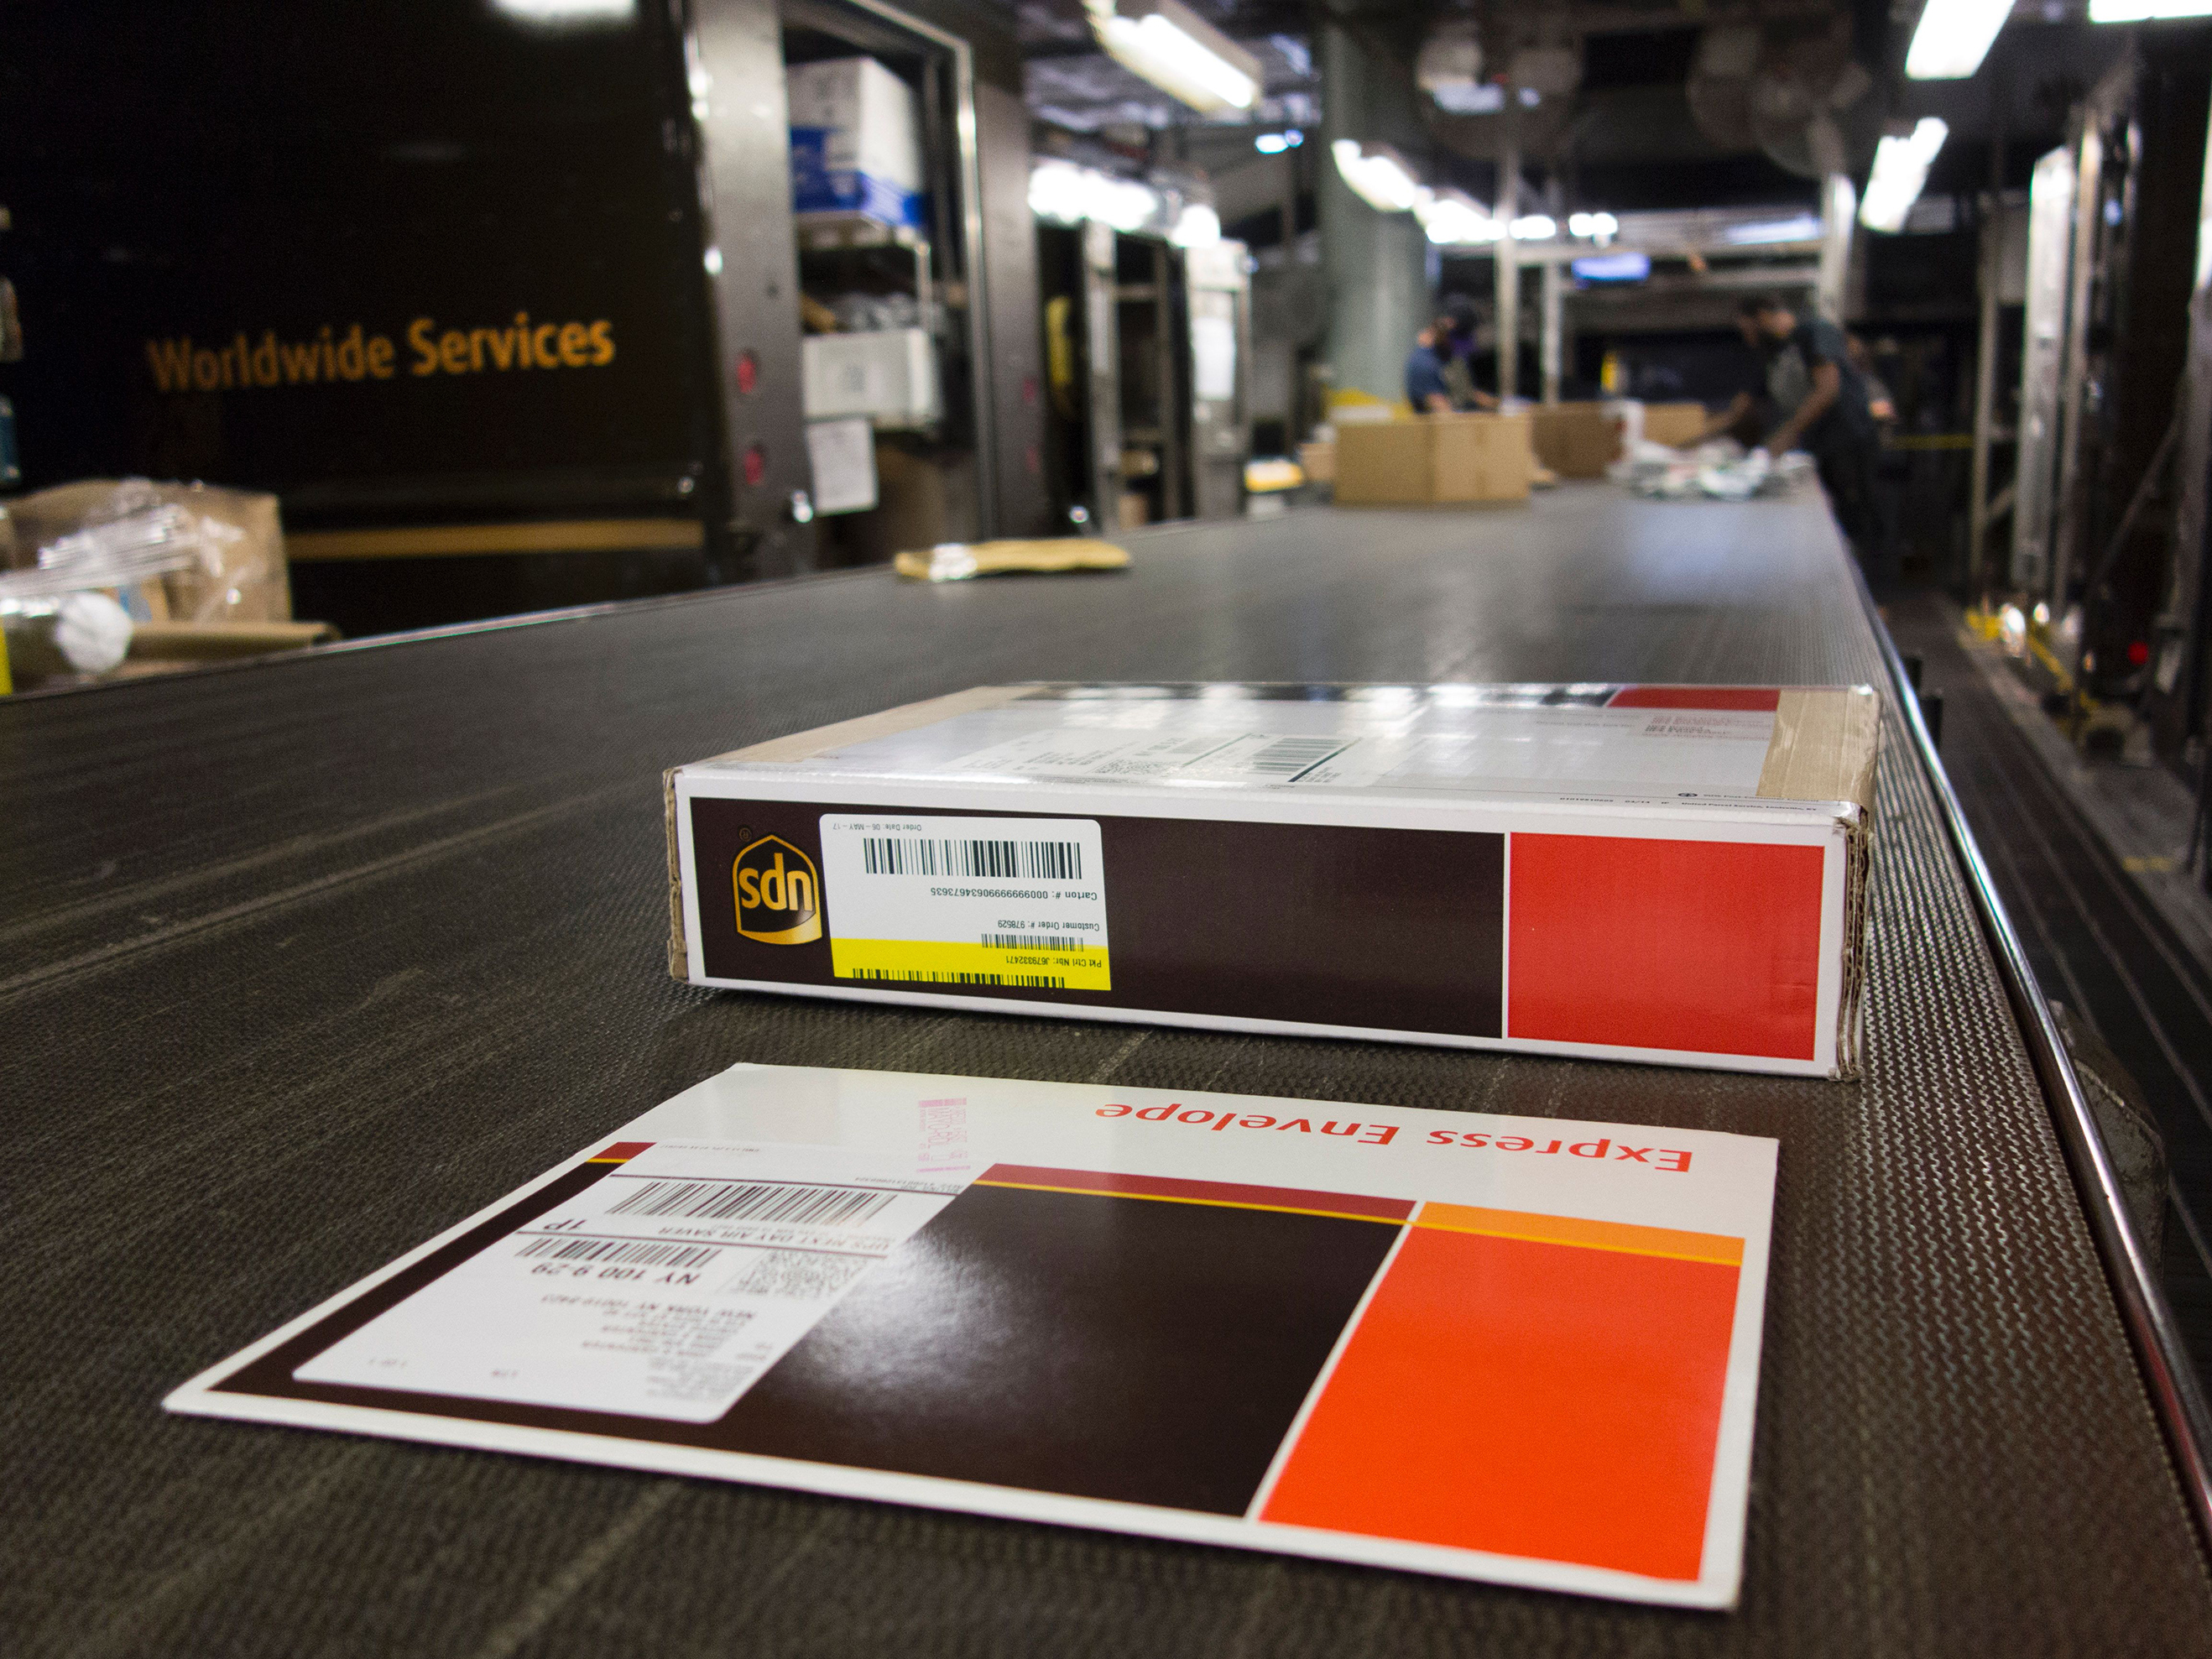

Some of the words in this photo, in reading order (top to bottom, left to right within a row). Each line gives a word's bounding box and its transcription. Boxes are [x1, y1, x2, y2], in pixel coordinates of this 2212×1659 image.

[146, 322, 395, 392] Worldwide
[408, 311, 616, 377] Services
[848, 822, 864, 831] MAY
[883, 823, 901, 832] Date:
[903, 823, 922, 832] Order
[738, 853, 813, 911] ups
[930, 887, 1048, 899] 00099999990634673635
[1051, 890, 1062, 899] #:
[1065, 891, 1098, 900] Carton
[997, 920, 1025, 928] 978529
[1038, 921, 1059, 930] Order
[1062, 921, 1100, 931] Customer
[1005, 955, 1051, 965] J679332471
[1052, 957, 1070, 966] Nbr:
[1072, 958, 1087, 967] Ctrl
[1089, 959, 1102, 968] Pkt
[1094, 1103, 1401, 1146] Envelope
[1426, 1129, 1693, 1173] Express
[543, 1218, 587, 1231] 1P
[720, 1229, 754, 1239] AIR
[758, 1233, 794, 1243] DAY
[597, 1266, 646, 1281] 100
[655, 1270, 702, 1286] NY
